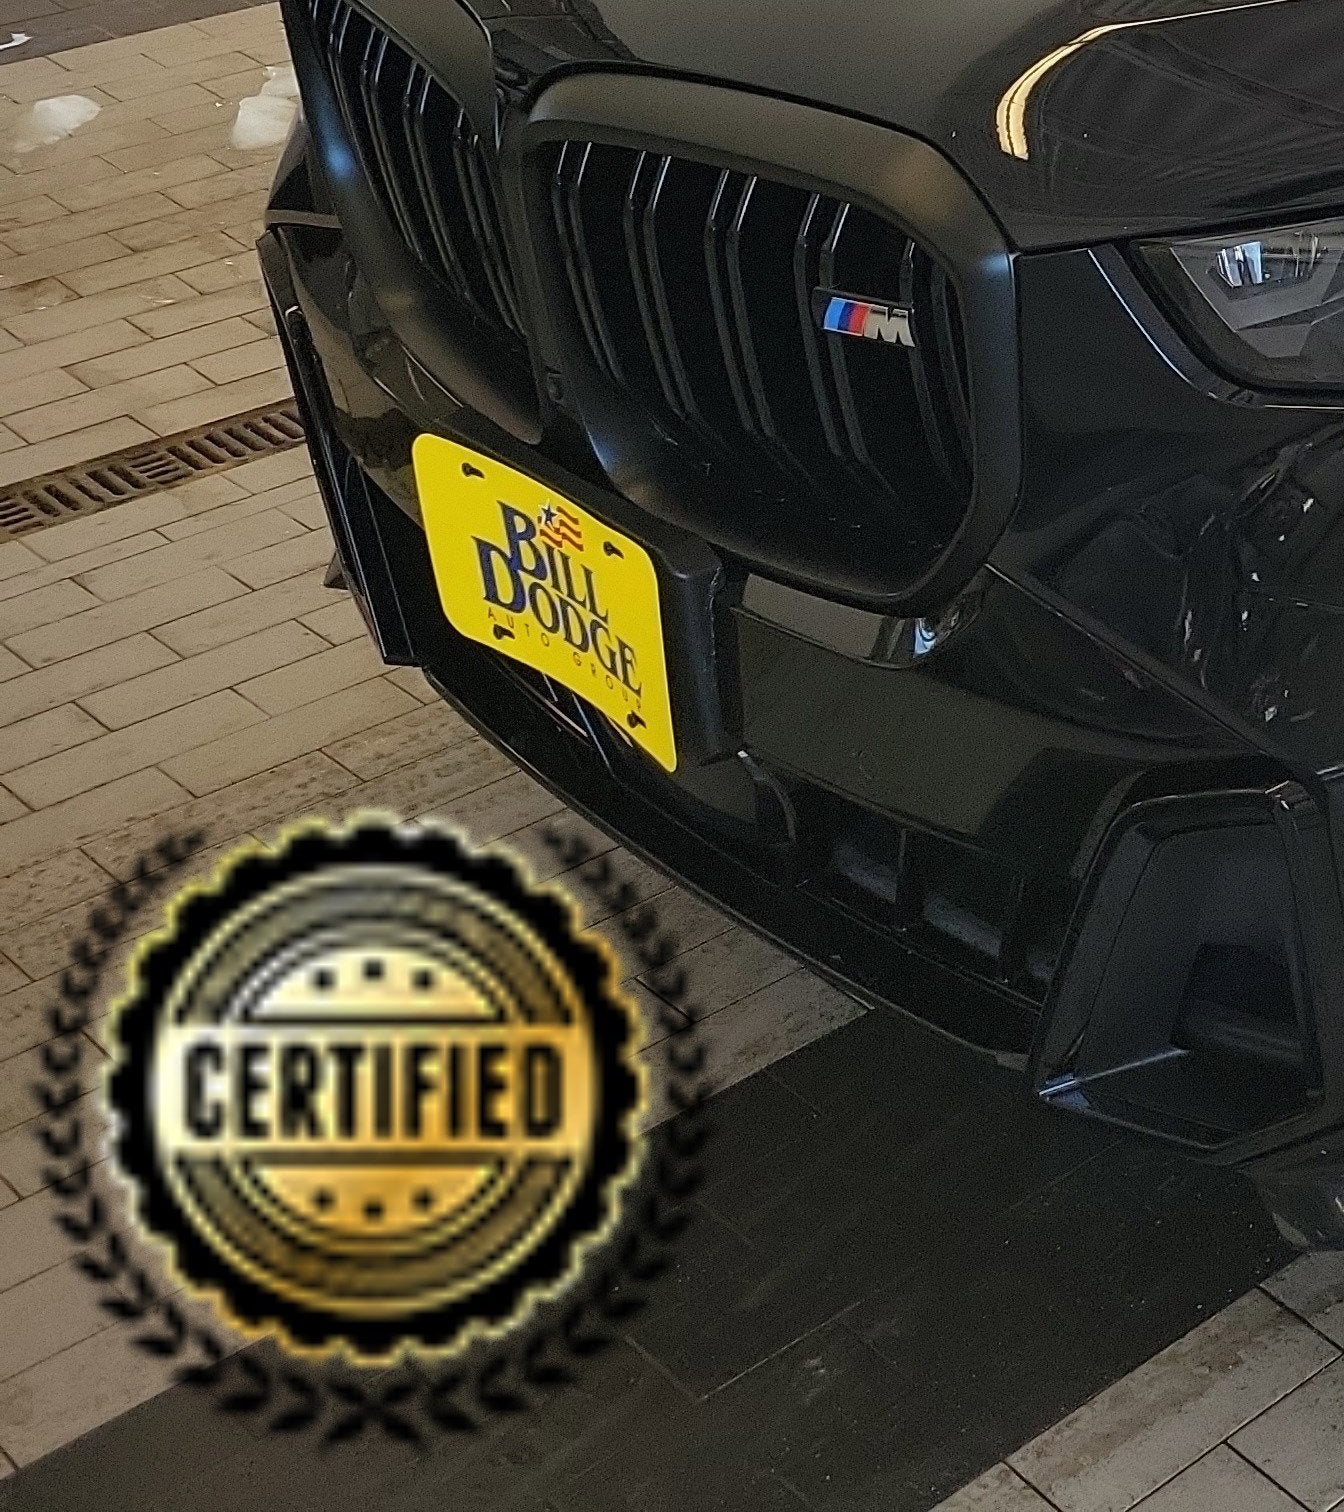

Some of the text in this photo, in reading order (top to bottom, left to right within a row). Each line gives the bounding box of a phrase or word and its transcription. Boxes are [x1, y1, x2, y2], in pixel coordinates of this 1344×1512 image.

[863, 305, 916, 348] M
[470, 535, 643, 699] DODGE
[496, 499, 610, 626] BILL
[487, 607, 642, 711] AUTO GROUP
